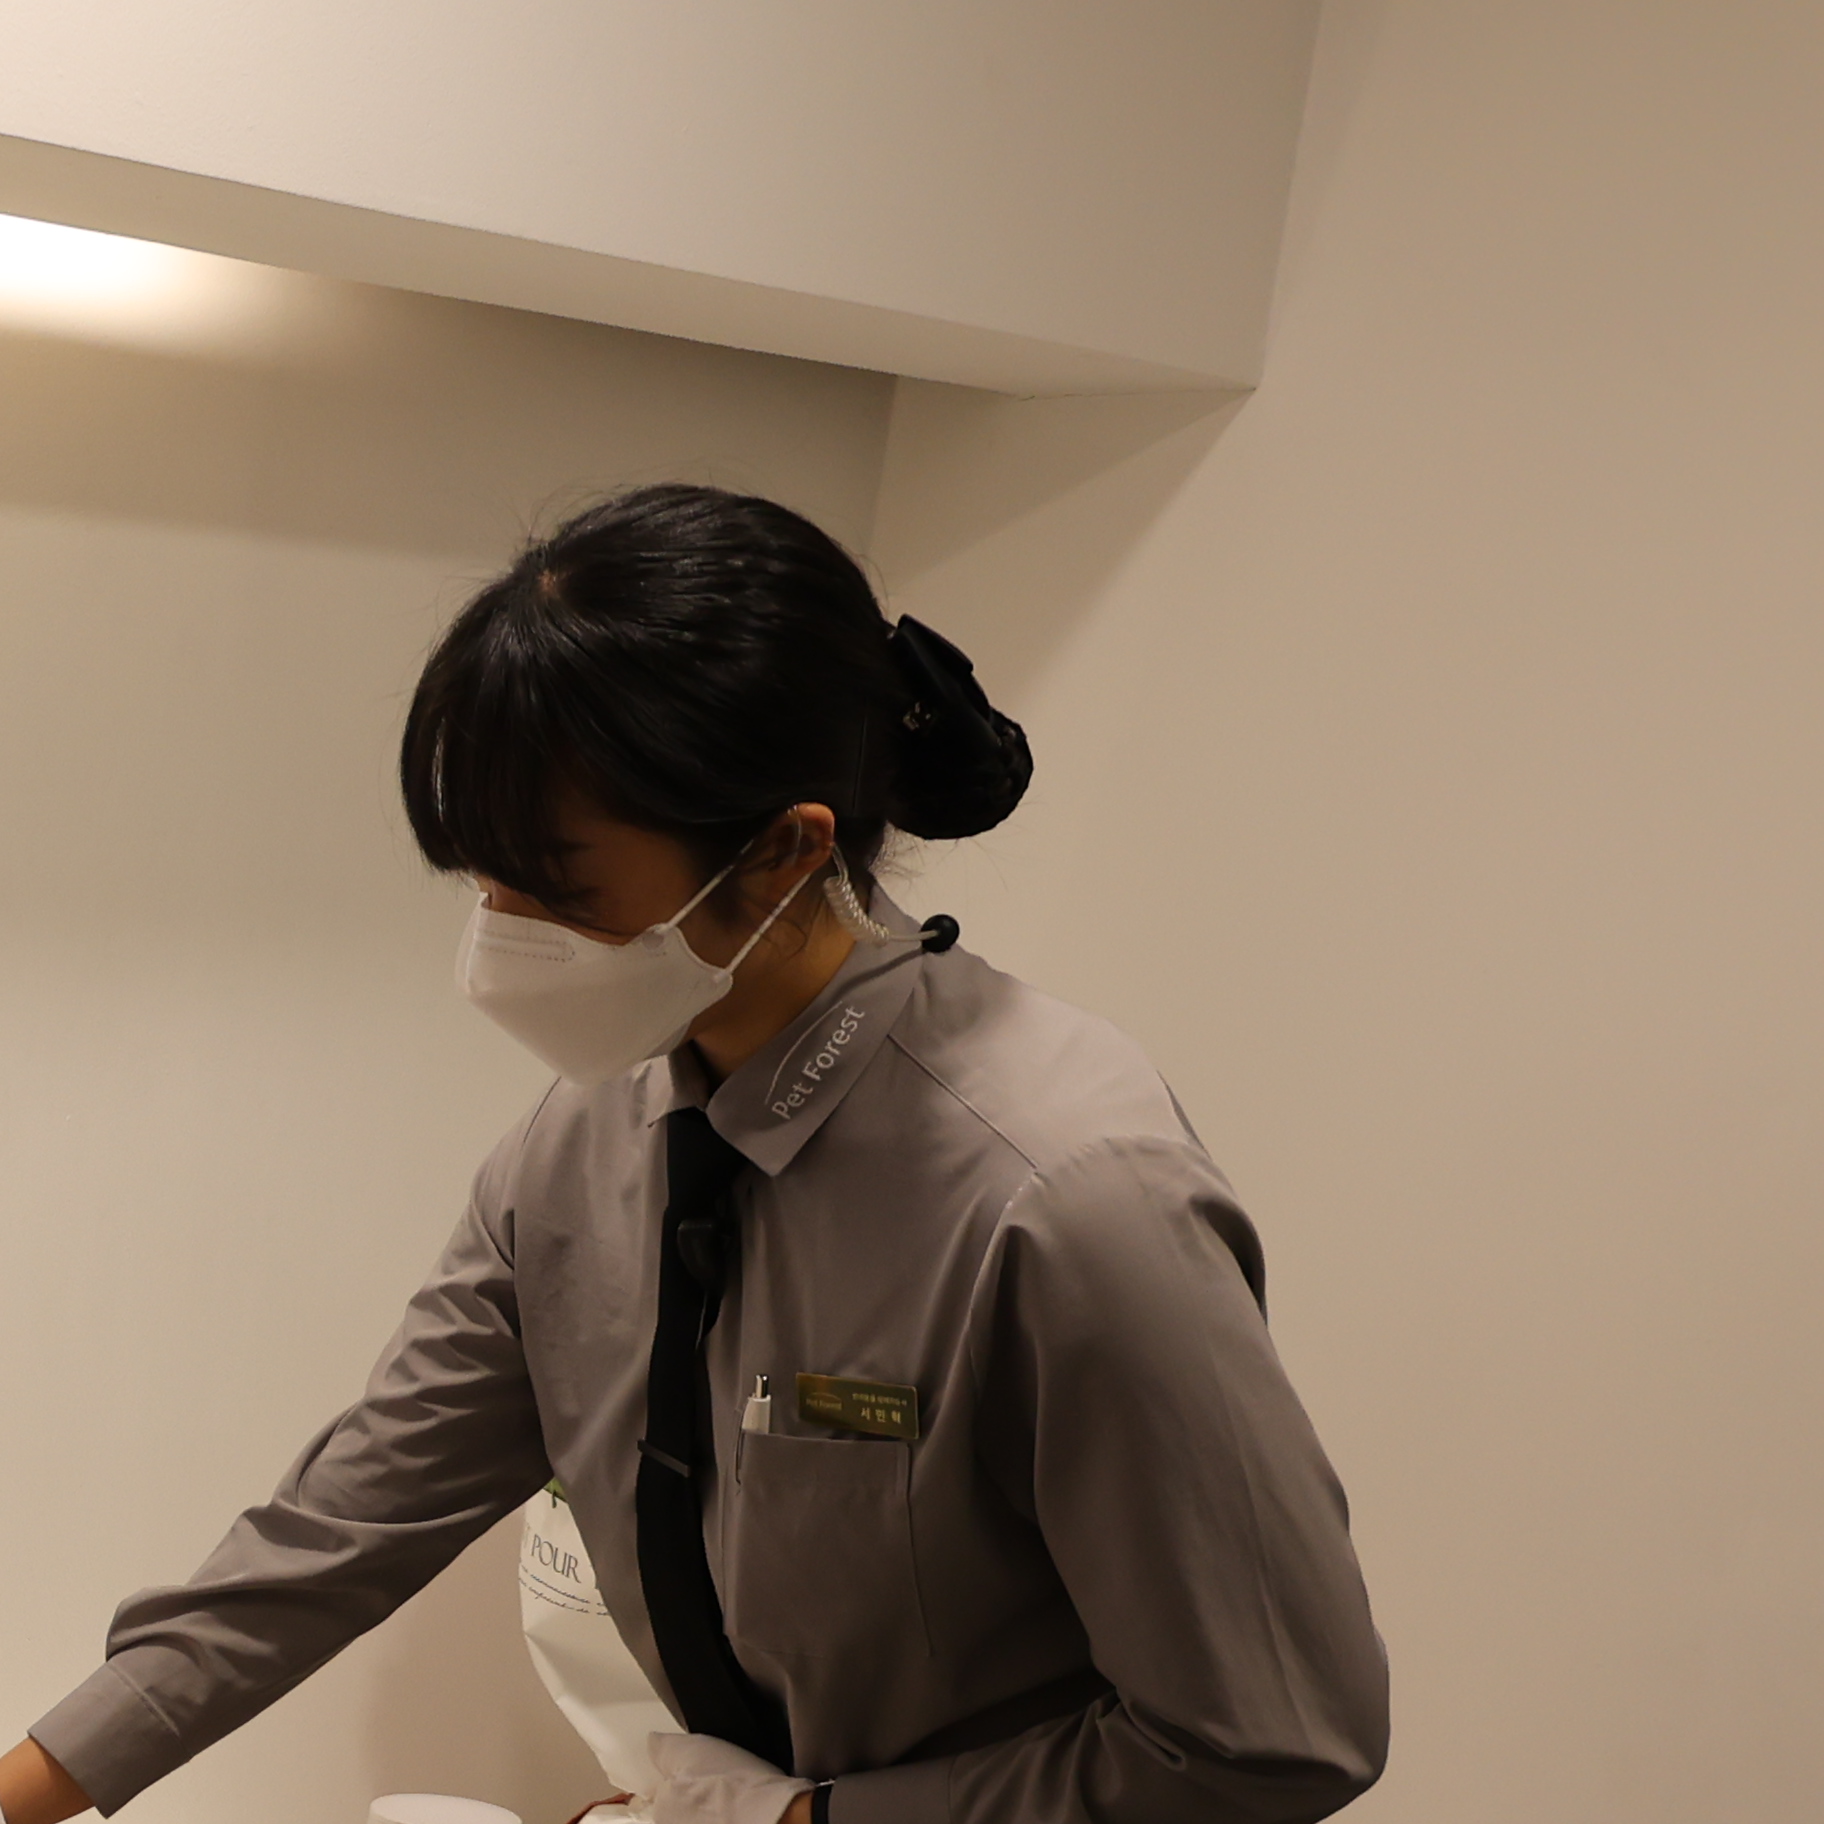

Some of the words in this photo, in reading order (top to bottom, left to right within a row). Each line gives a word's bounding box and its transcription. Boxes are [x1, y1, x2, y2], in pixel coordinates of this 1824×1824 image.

[772, 1082, 813, 1119] Pet
[802, 1006, 865, 1081] Forest
[531, 1533, 582, 1584] POUR
